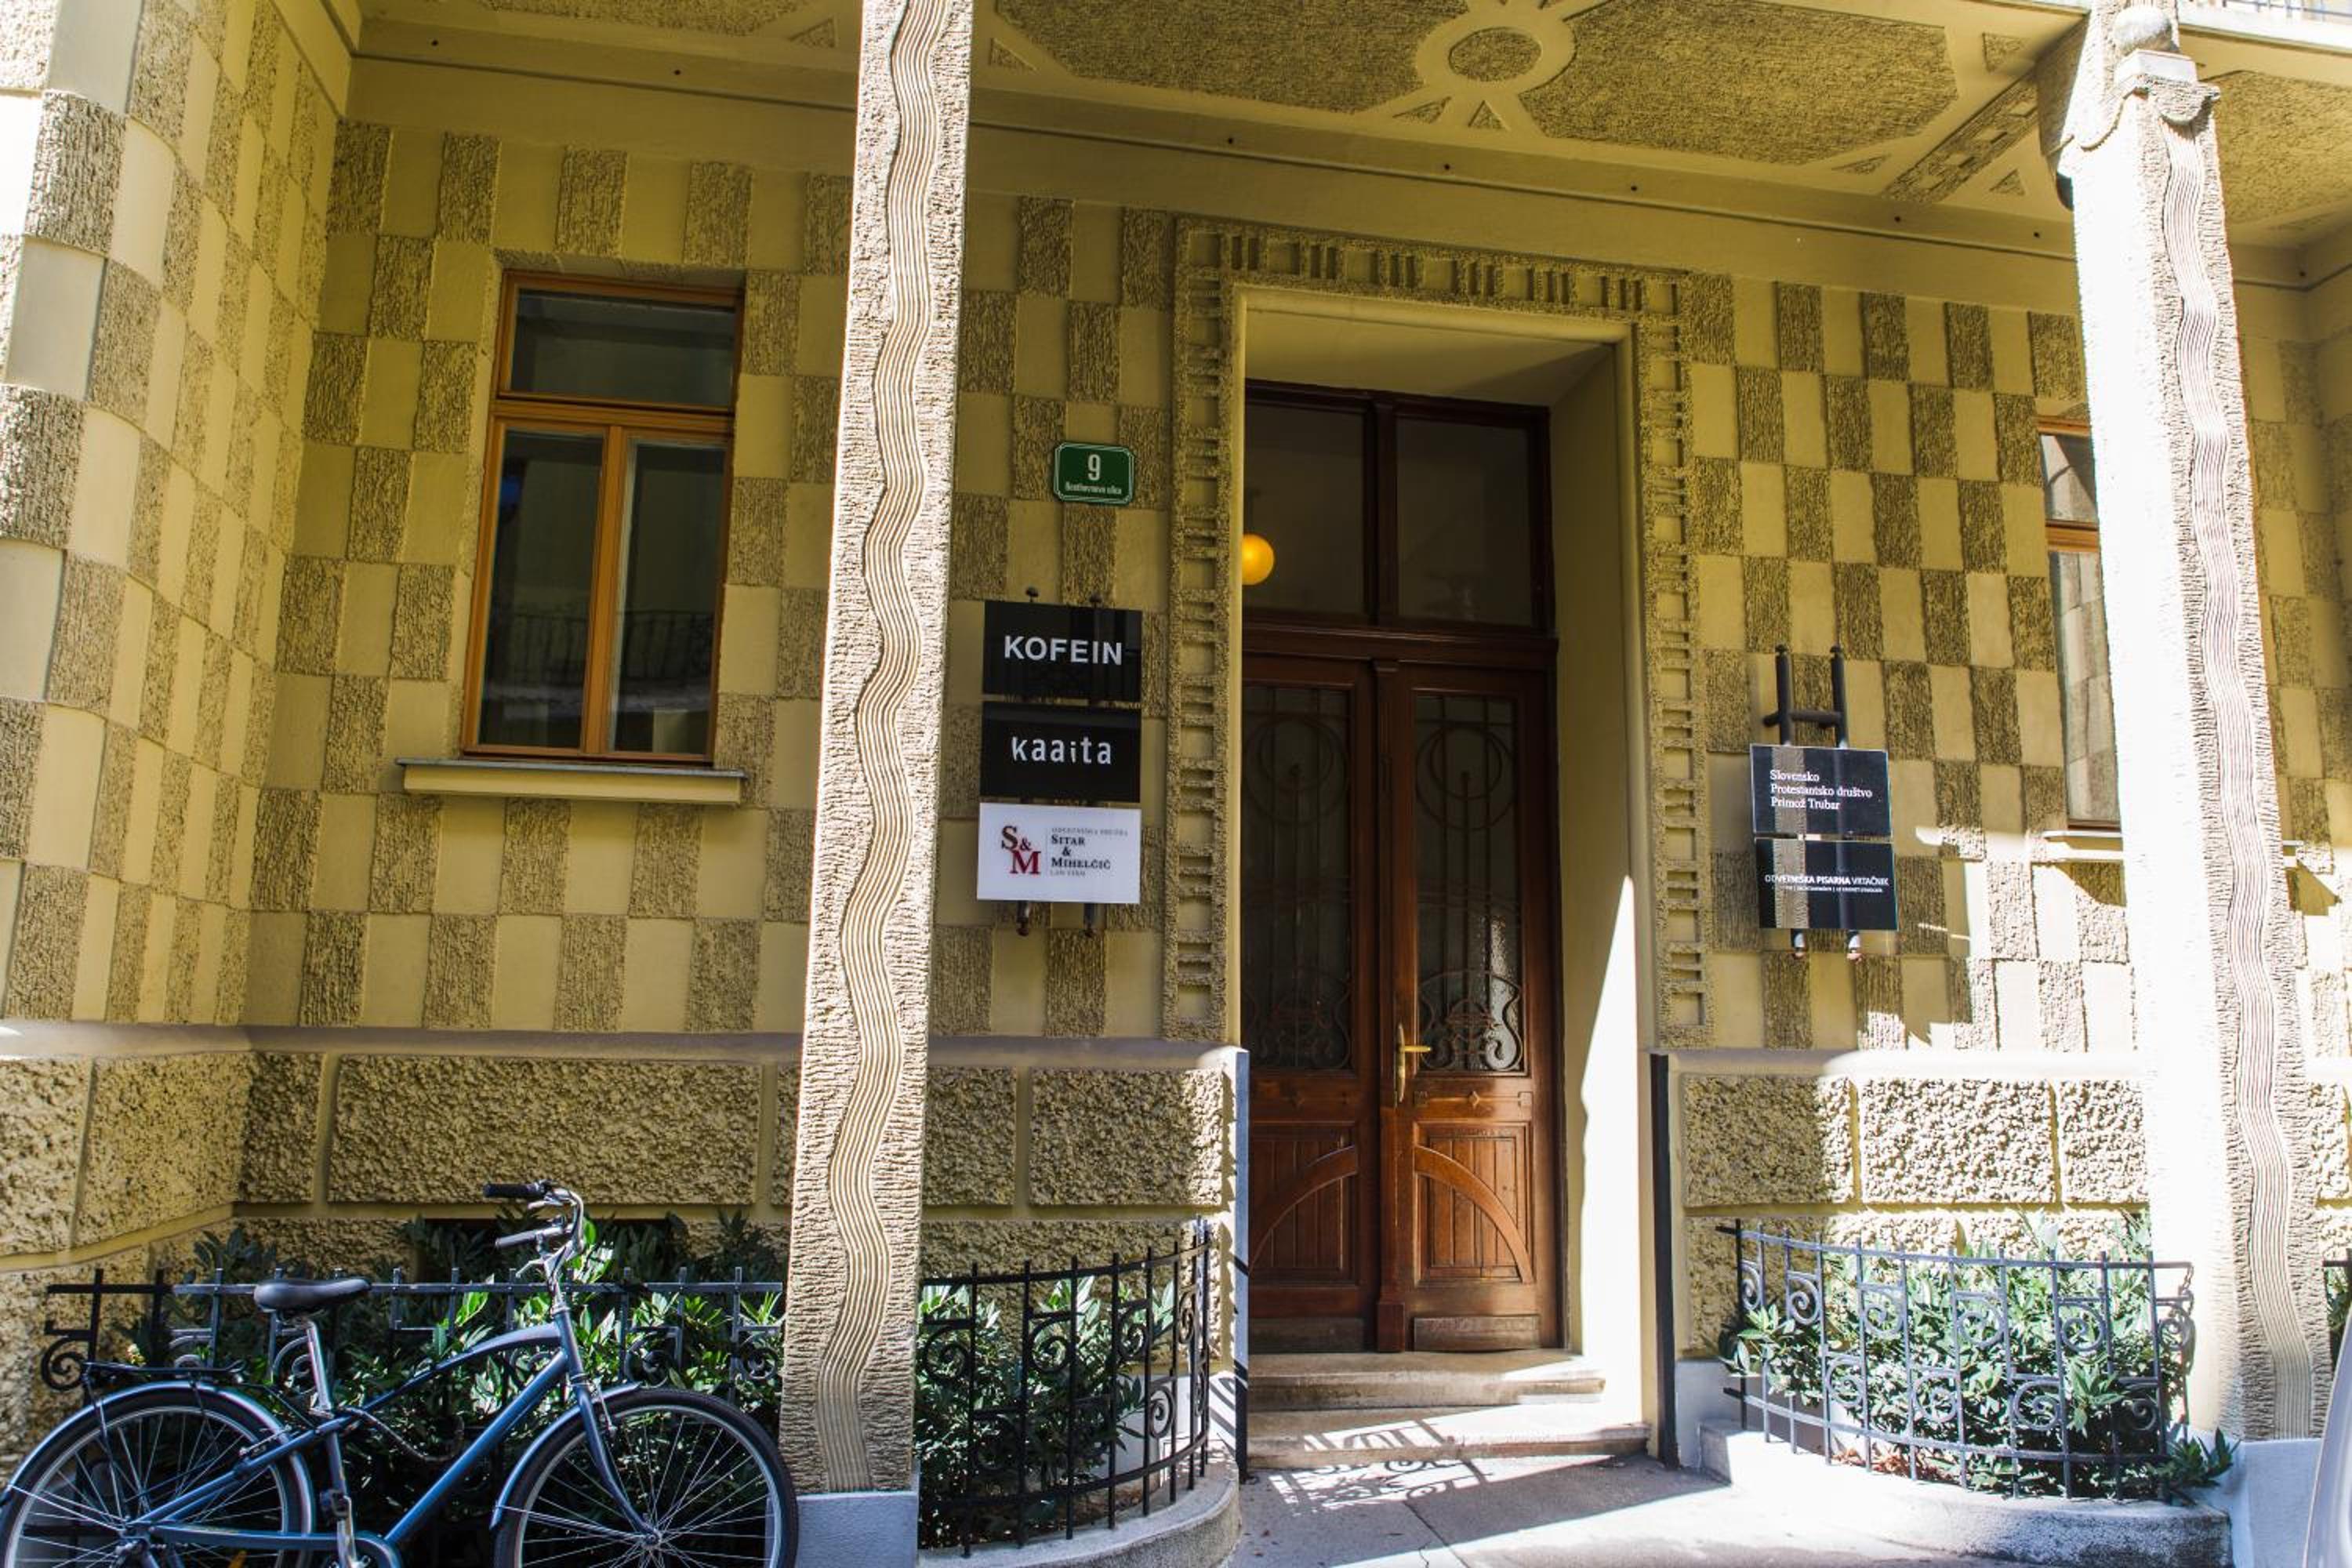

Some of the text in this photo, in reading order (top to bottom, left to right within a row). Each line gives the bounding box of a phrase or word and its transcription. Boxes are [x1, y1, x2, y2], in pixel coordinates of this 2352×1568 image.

[1087, 454, 1102, 481] 9
[1004, 635, 1122, 665] KOFEIN
[1769, 769, 1820, 782] Slovensko
[1770, 784, 1873, 798] Protestantsko društvo
[1807, 798, 1841, 810] Trubar
[1062, 846, 1072, 856] &
[1817, 875, 1850, 885] PISARNA
